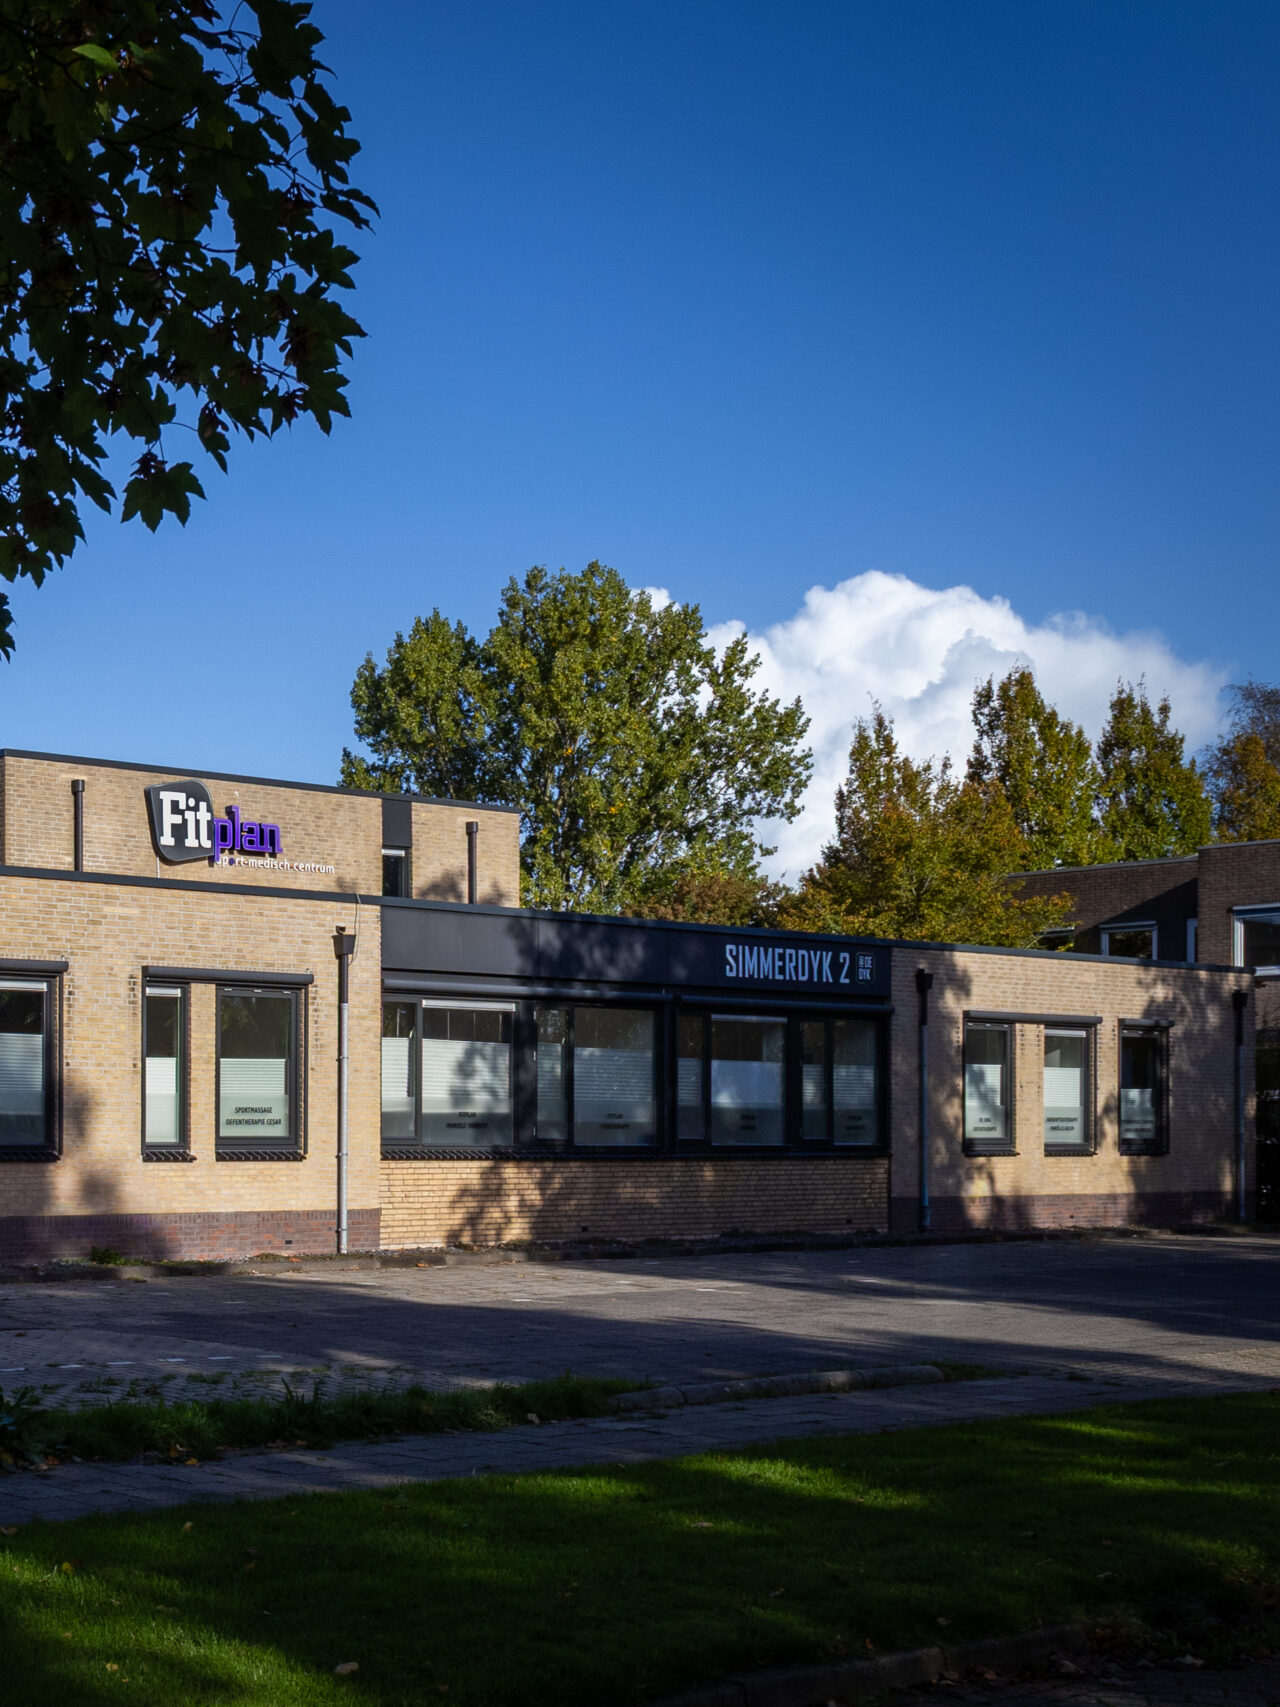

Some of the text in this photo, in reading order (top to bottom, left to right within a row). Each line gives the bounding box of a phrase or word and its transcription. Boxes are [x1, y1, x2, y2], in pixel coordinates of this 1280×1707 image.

[293, 861, 336, 874] centrum
[725, 944, 850, 984] SIMMERDYK 2
